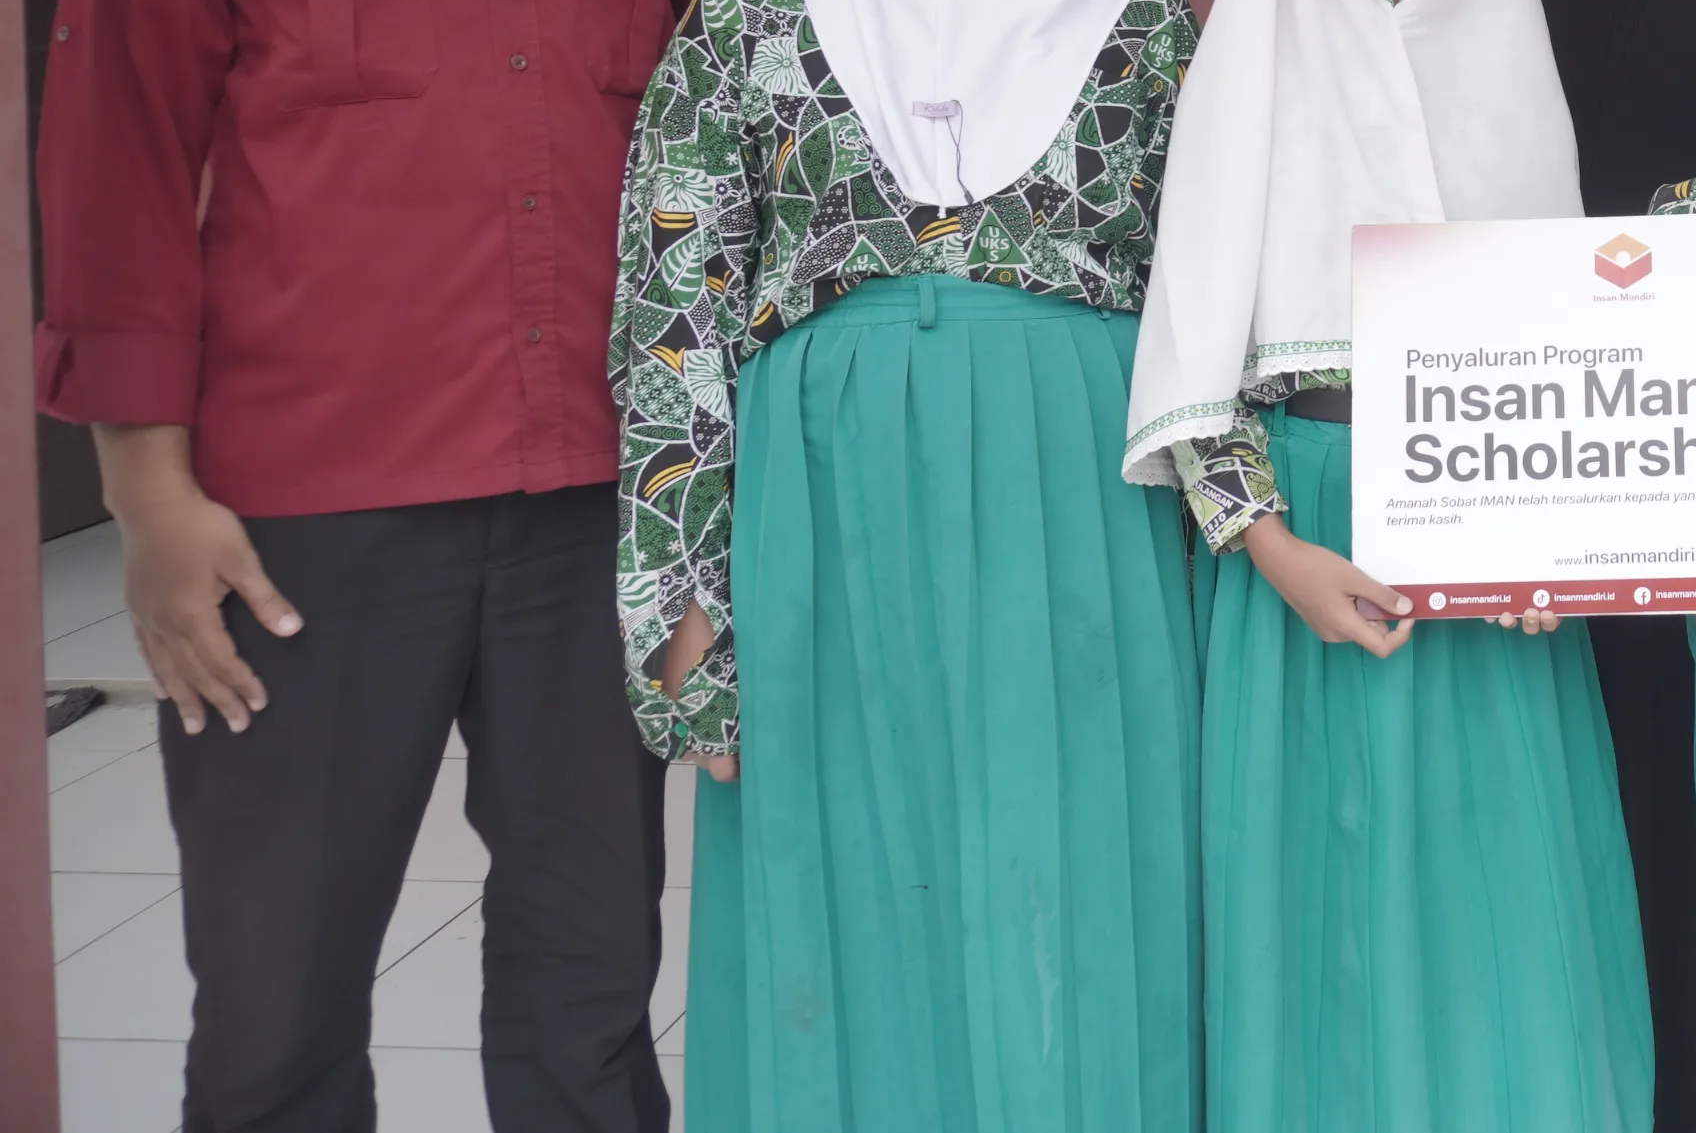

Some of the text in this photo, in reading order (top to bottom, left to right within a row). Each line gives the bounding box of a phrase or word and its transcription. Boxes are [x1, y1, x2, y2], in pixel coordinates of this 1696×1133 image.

[1593, 292, 1655, 303] Insan Mandiri
[1406, 345, 1644, 373] Penyaluran Program
[1405, 374, 1566, 423] Insan
[1194, 481, 1234, 510] ULANGAN
[1386, 497, 1437, 509] Amanah
[1440, 496, 1477, 508] Sobat
[1479, 495, 1515, 507] IMAN
[1518, 494, 1548, 506] telah
[1551, 492, 1621, 505] tersalurkan
[1624, 490, 1670, 504] kepada
[1386, 513, 1464, 527] terima kasih.
[1449, 594, 1512, 605] insanmandiri.id
[1553, 592, 1616, 603] insanmandiri.id
